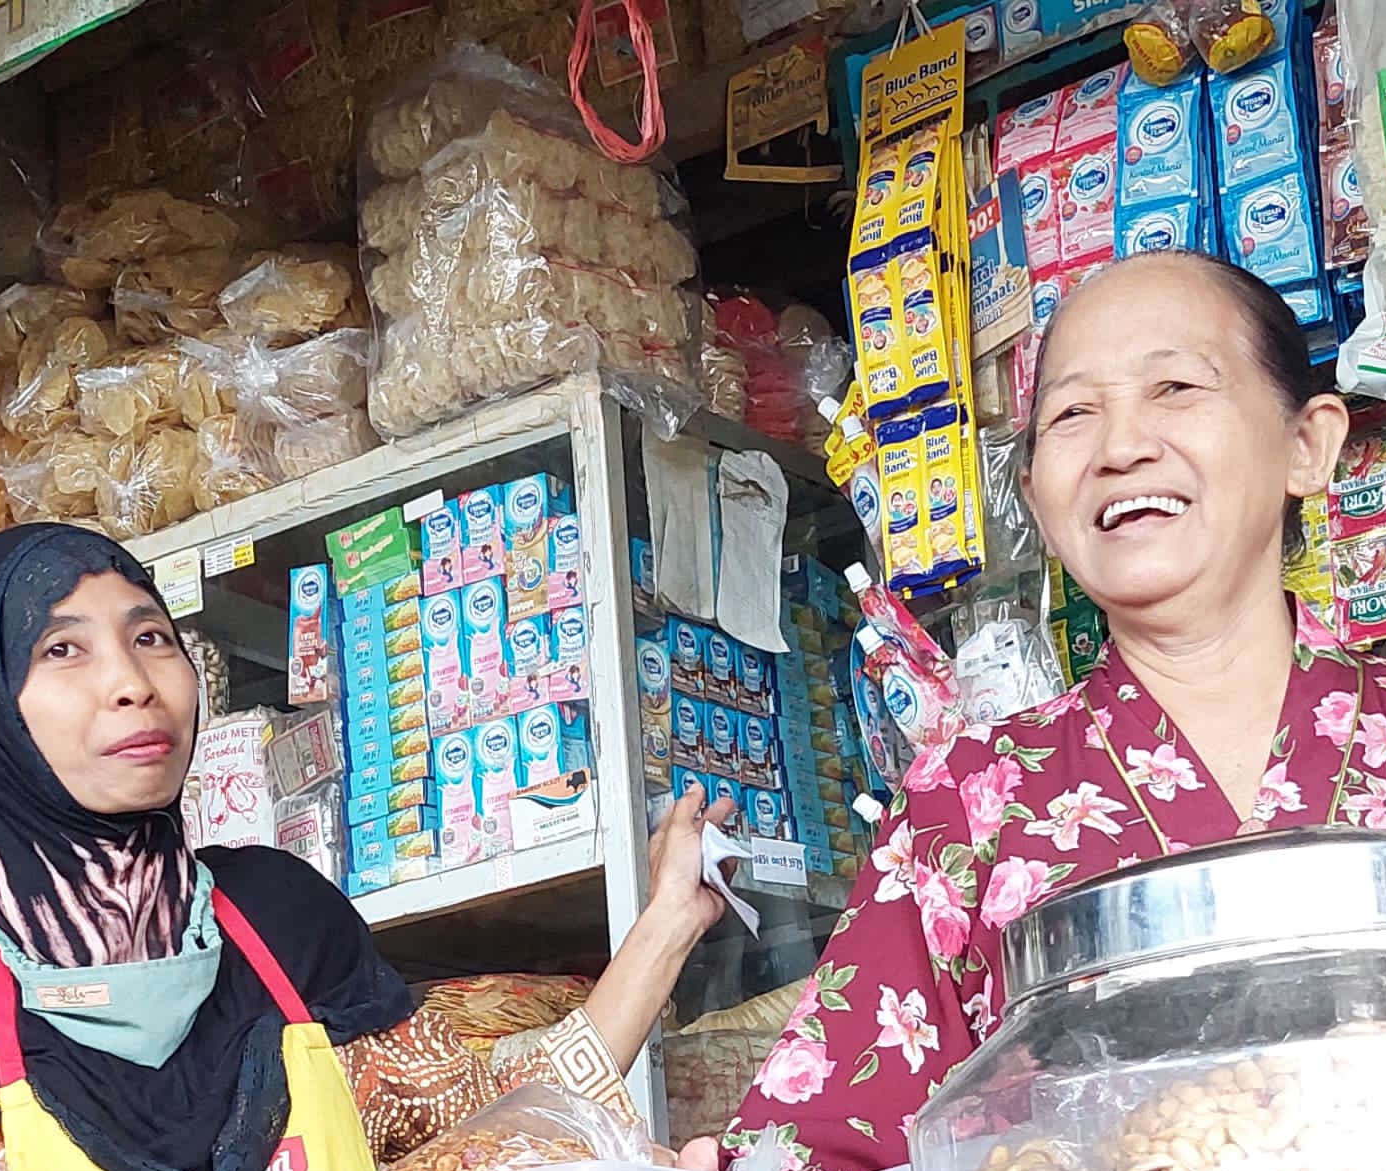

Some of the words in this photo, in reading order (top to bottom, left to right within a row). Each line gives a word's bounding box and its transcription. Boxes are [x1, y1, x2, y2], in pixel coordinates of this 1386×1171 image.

[885, 71, 918, 97] Blue
[918, 51, 958, 81] Band
[1261, 134, 1287, 150] Manis
[898, 199, 926, 218] Band
[858, 216, 886, 236] Band
[899, 211, 923, 226] Blue
[859, 228, 883, 244] Blue
[911, 350, 939, 370] Band
[915, 363, 939, 379] Blue
[925, 434, 948, 449] Blue
[884, 448, 908, 463] Blue
[925, 446, 950, 461] Band
[884, 460, 911, 476] Band
[203, 740, 246, 763] Barokah
